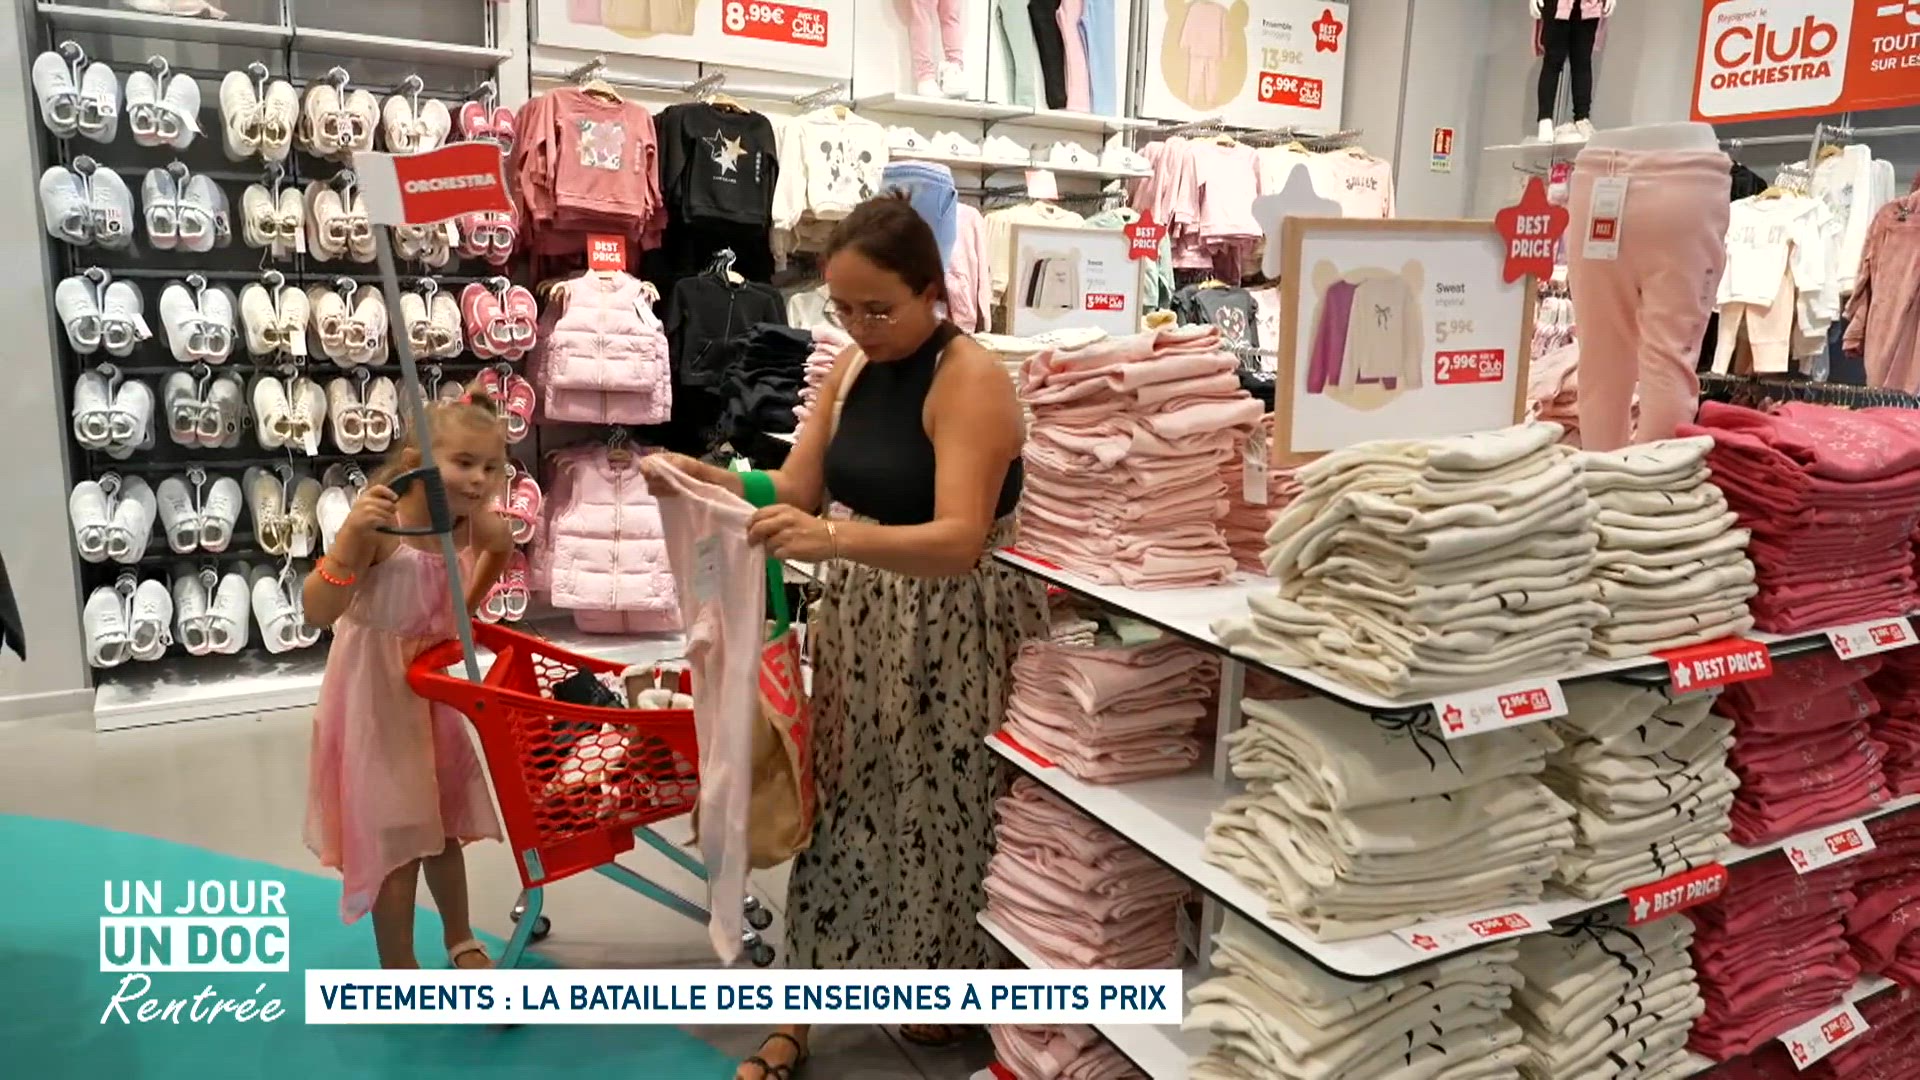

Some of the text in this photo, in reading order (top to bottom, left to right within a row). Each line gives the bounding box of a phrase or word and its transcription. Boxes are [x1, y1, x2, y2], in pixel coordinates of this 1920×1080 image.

[726, 2, 785, 31] 8.99€
[792, 18, 825, 35] Club
[1714, 15, 1838, 69] Club
[1710, 60, 1832, 90] ORCHESTRA
[1870, 57, 1897, 72] SUR
[1261, 76, 1298, 99] 6.99€
[404, 173, 497, 194] ORCHESTRA
[1135, 227, 1156, 237] BEST
[1516, 215, 1551, 235] BEST
[594, 241, 618, 252] BEST
[1132, 239, 1157, 250] PRICE
[1511, 238, 1552, 259] PRICE
[592, 250, 622, 263] PRICE
[1436, 282, 1466, 293] Sweat
[1437, 353, 1478, 380] 2.99€
[1693, 650, 1766, 681] BEST PRICE
[1653, 874, 1722, 912] BEST PRICE
